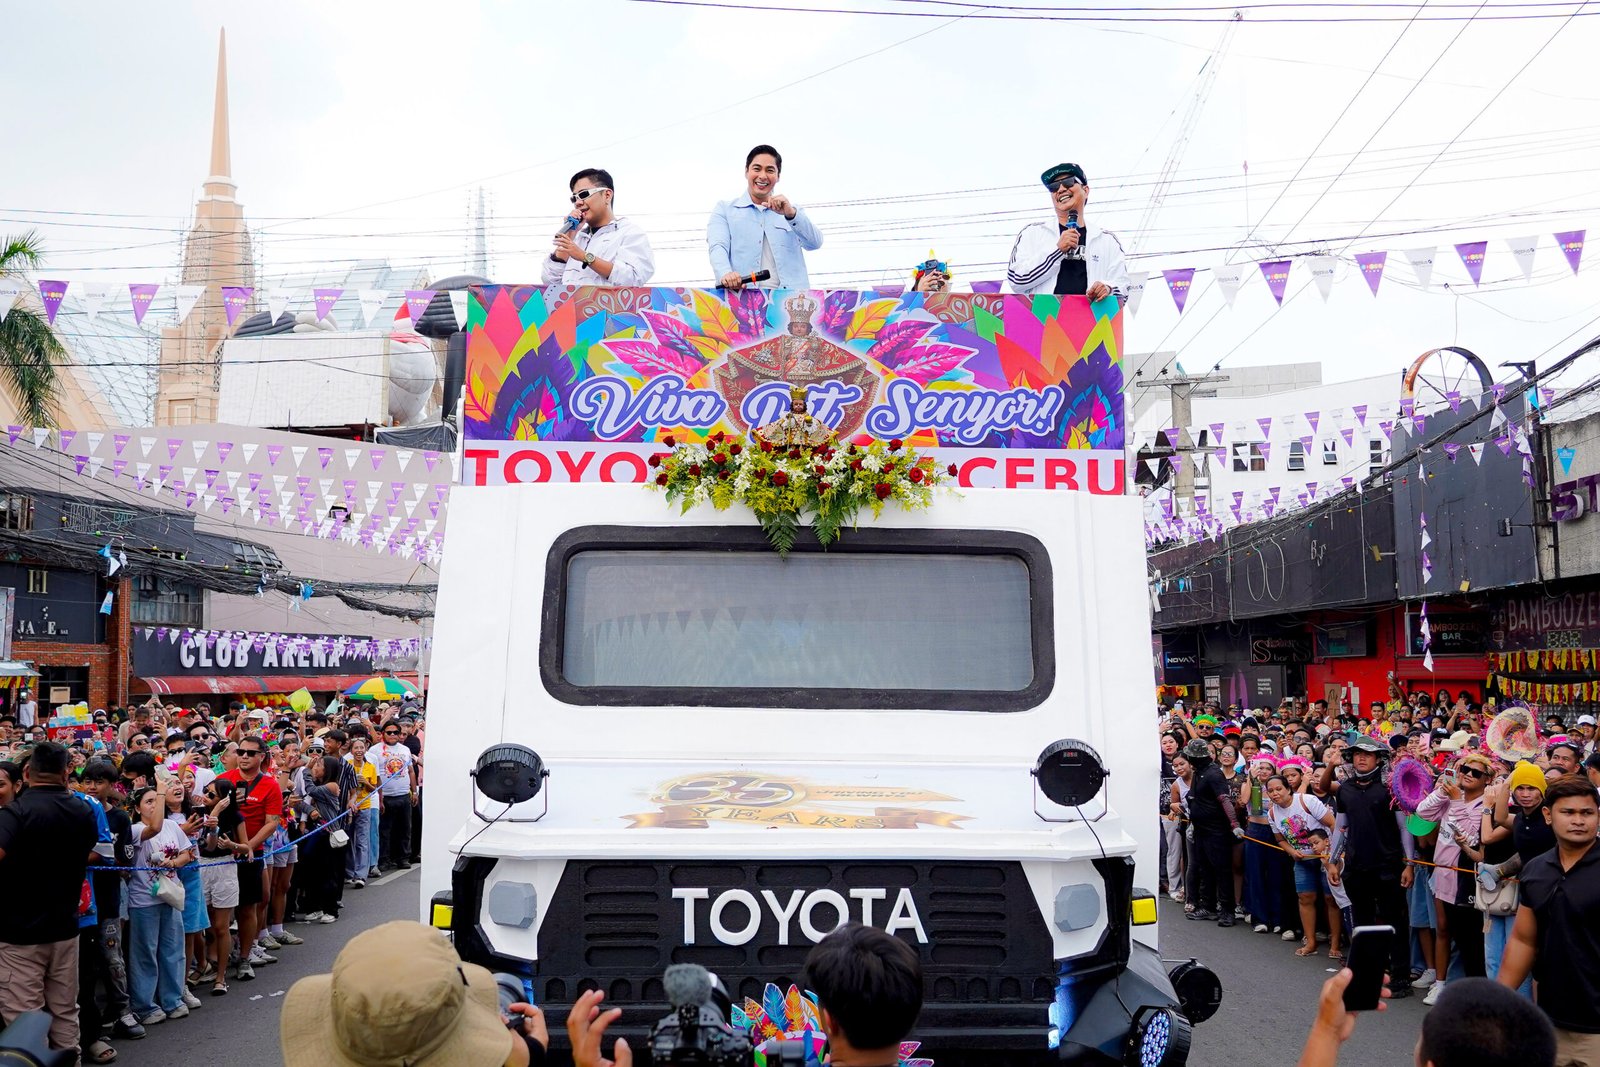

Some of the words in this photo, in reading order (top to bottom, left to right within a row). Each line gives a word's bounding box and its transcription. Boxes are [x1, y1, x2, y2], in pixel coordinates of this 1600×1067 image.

[570, 374, 727, 439] Viva
[742, 380, 863, 442] Pt
[866, 377, 1064, 445] Senyor!
[465, 449, 673, 486] TOYO
[1508, 592, 1600, 632] BAMBOOZE
[1441, 632, 1461, 640] BAR
[1547, 630, 1582, 649] BAR
[1167, 655, 1196, 664] NOVAX
[691, 806, 887, 829] YEARS
[671, 887, 929, 946] TOYOTA
